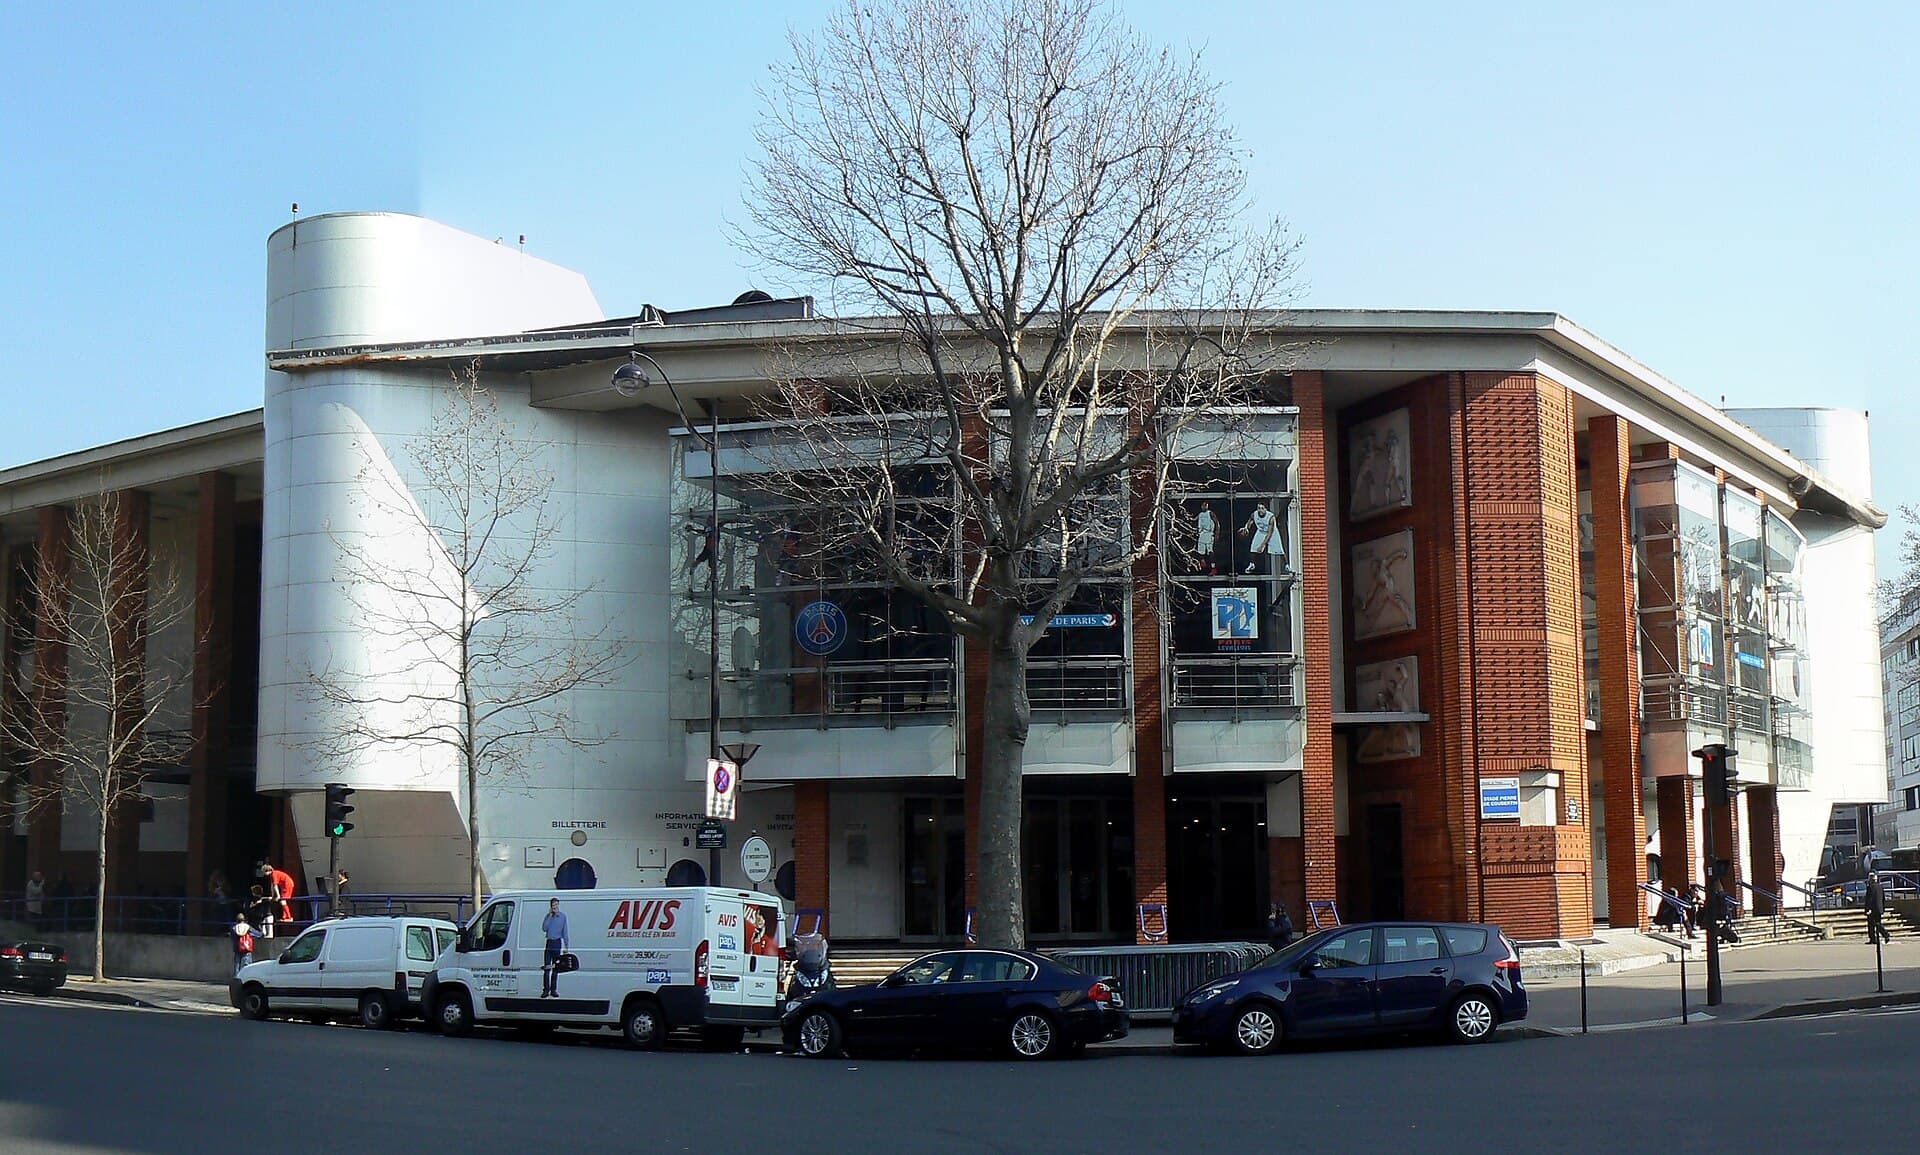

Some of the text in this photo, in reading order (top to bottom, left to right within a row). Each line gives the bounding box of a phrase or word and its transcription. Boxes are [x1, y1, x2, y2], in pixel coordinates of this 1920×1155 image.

[804, 604, 837, 618] PARIS
[1055, 617, 1068, 625] DE
[1070, 617, 1097, 625] PARIS
[655, 813, 706, 821] INFORMATIO
[551, 821, 607, 829] BILLETTERIE
[608, 900, 681, 930] AVIS
[718, 914, 738, 927] AVIS
